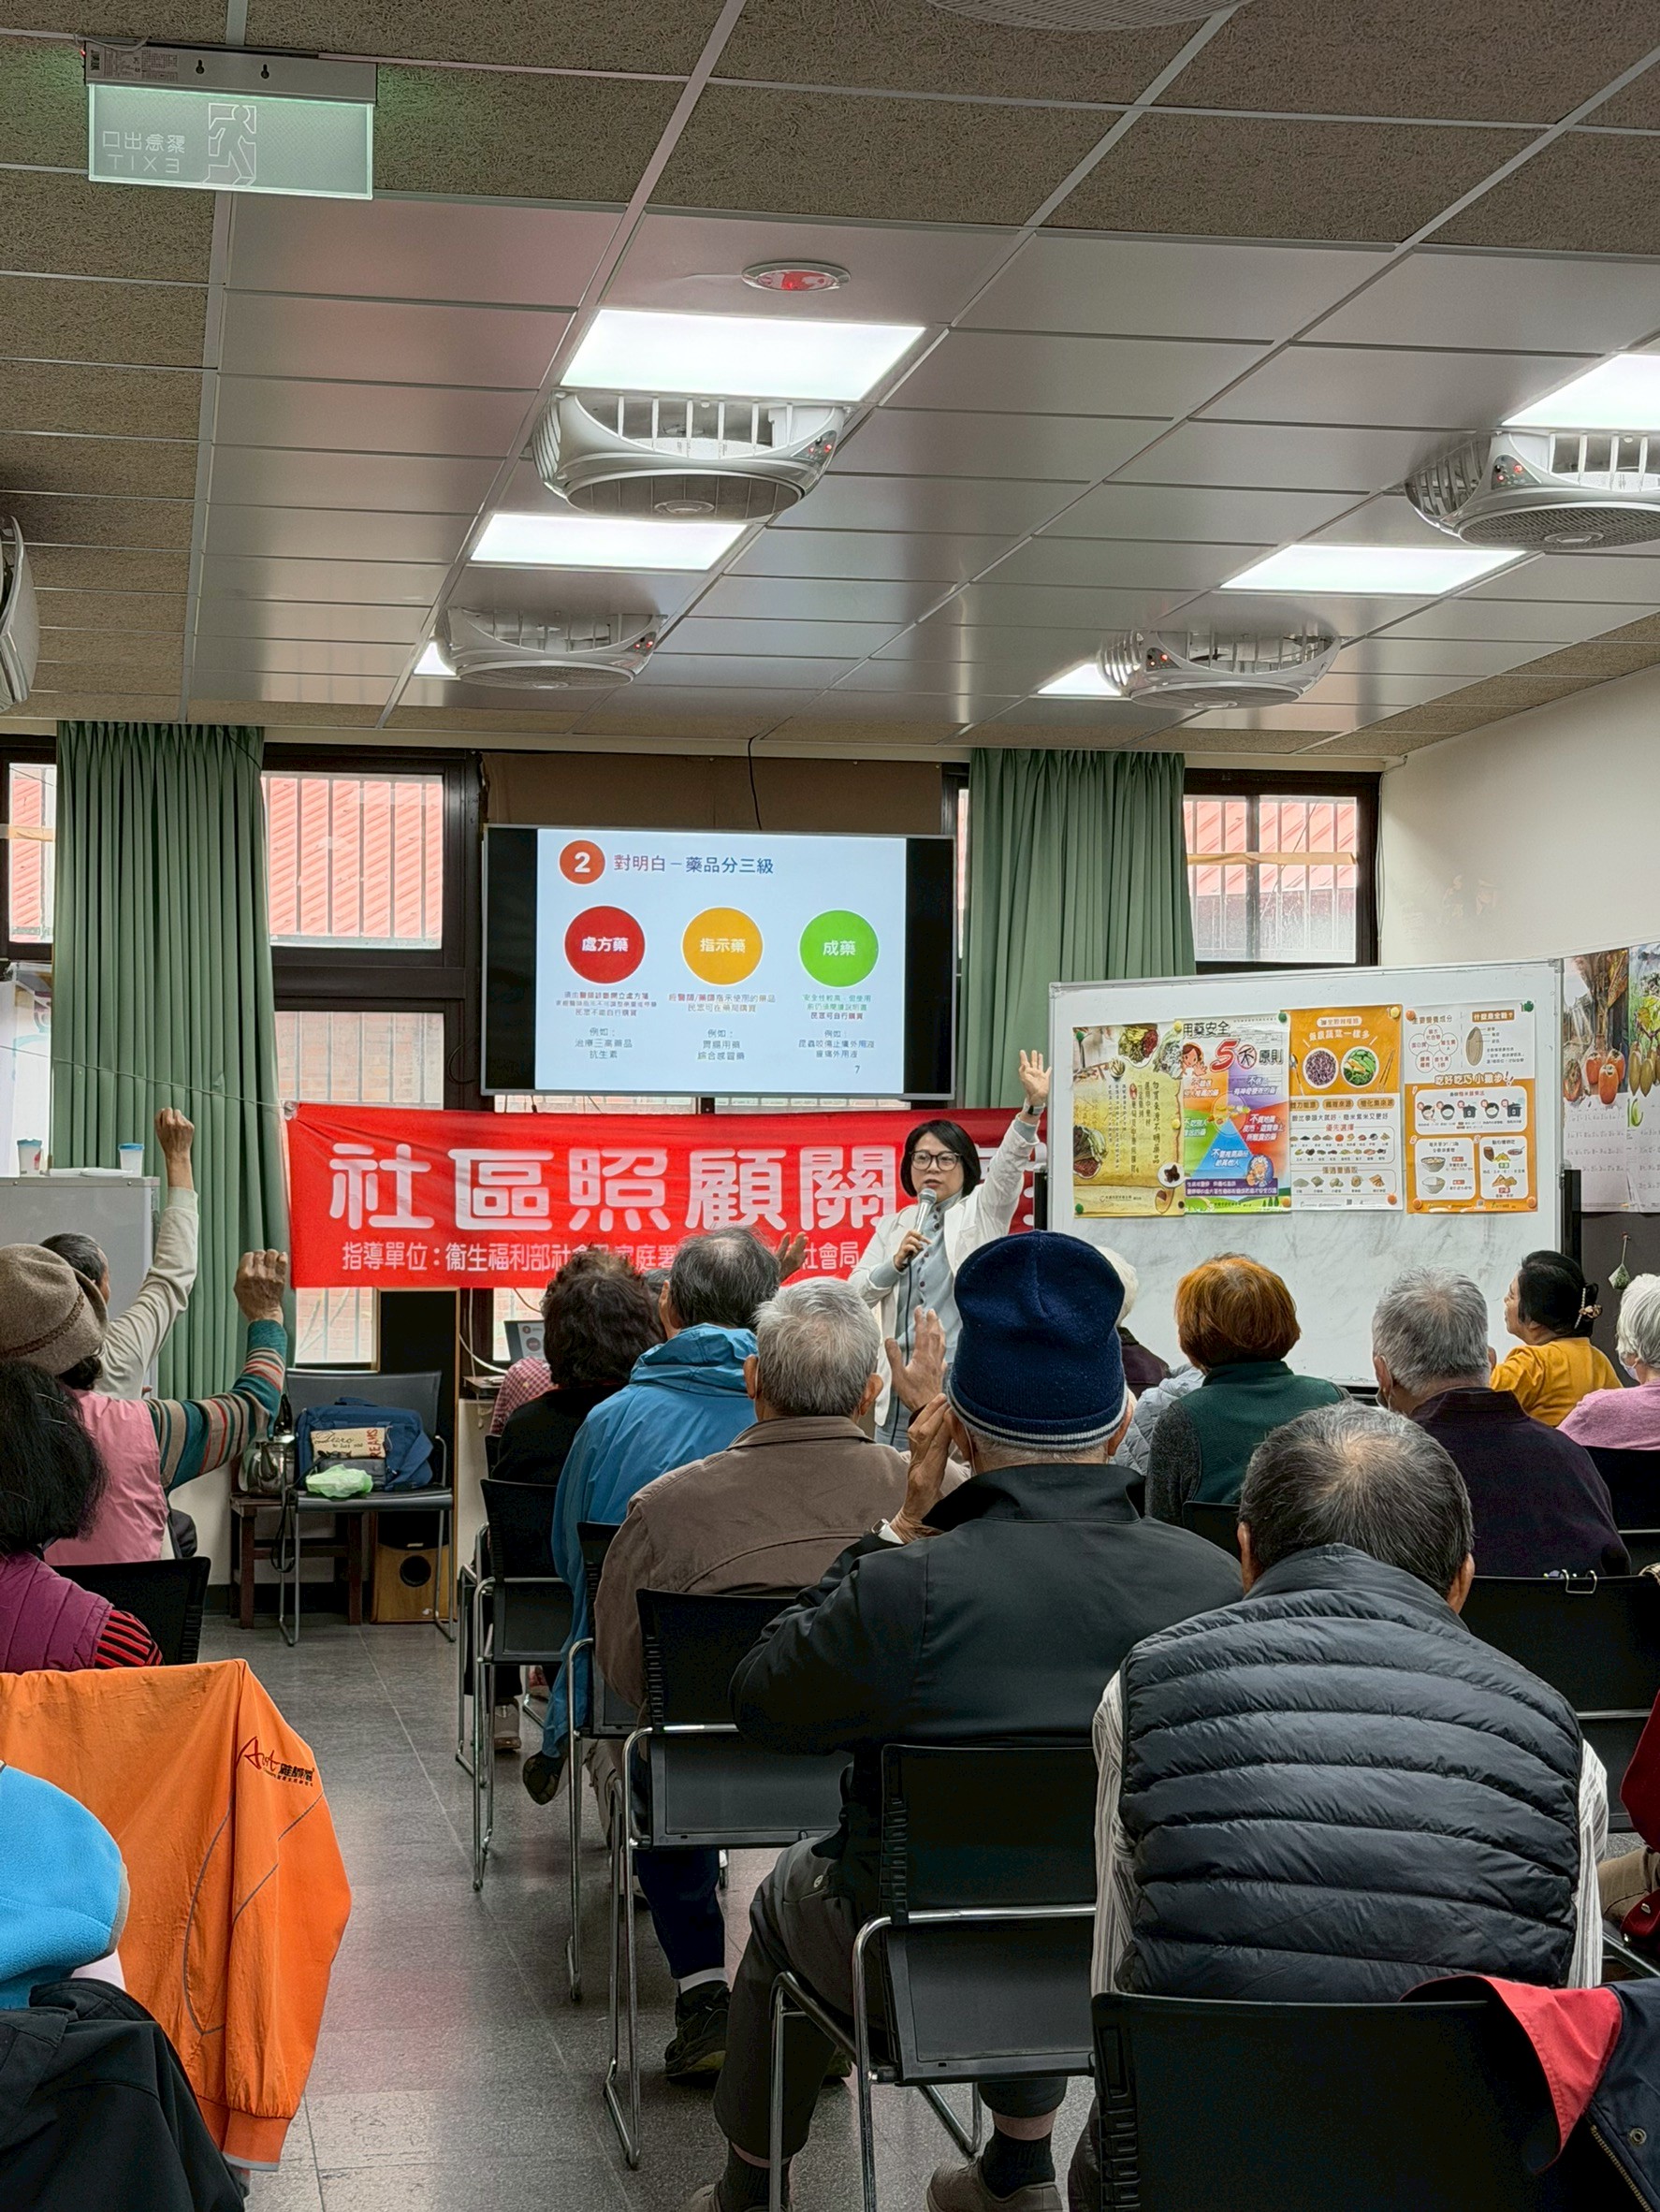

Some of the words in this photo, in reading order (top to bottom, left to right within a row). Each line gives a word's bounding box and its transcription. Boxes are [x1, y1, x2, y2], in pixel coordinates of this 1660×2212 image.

[573, 851, 591, 873] 2
[581, 937, 629, 953] 處方藥
[700, 938, 746, 954] 指示藥
[823, 939, 856, 956] 成藥
[1183, 1021, 1230, 1037] 用藥安全
[854, 1065, 861, 1074] 7
